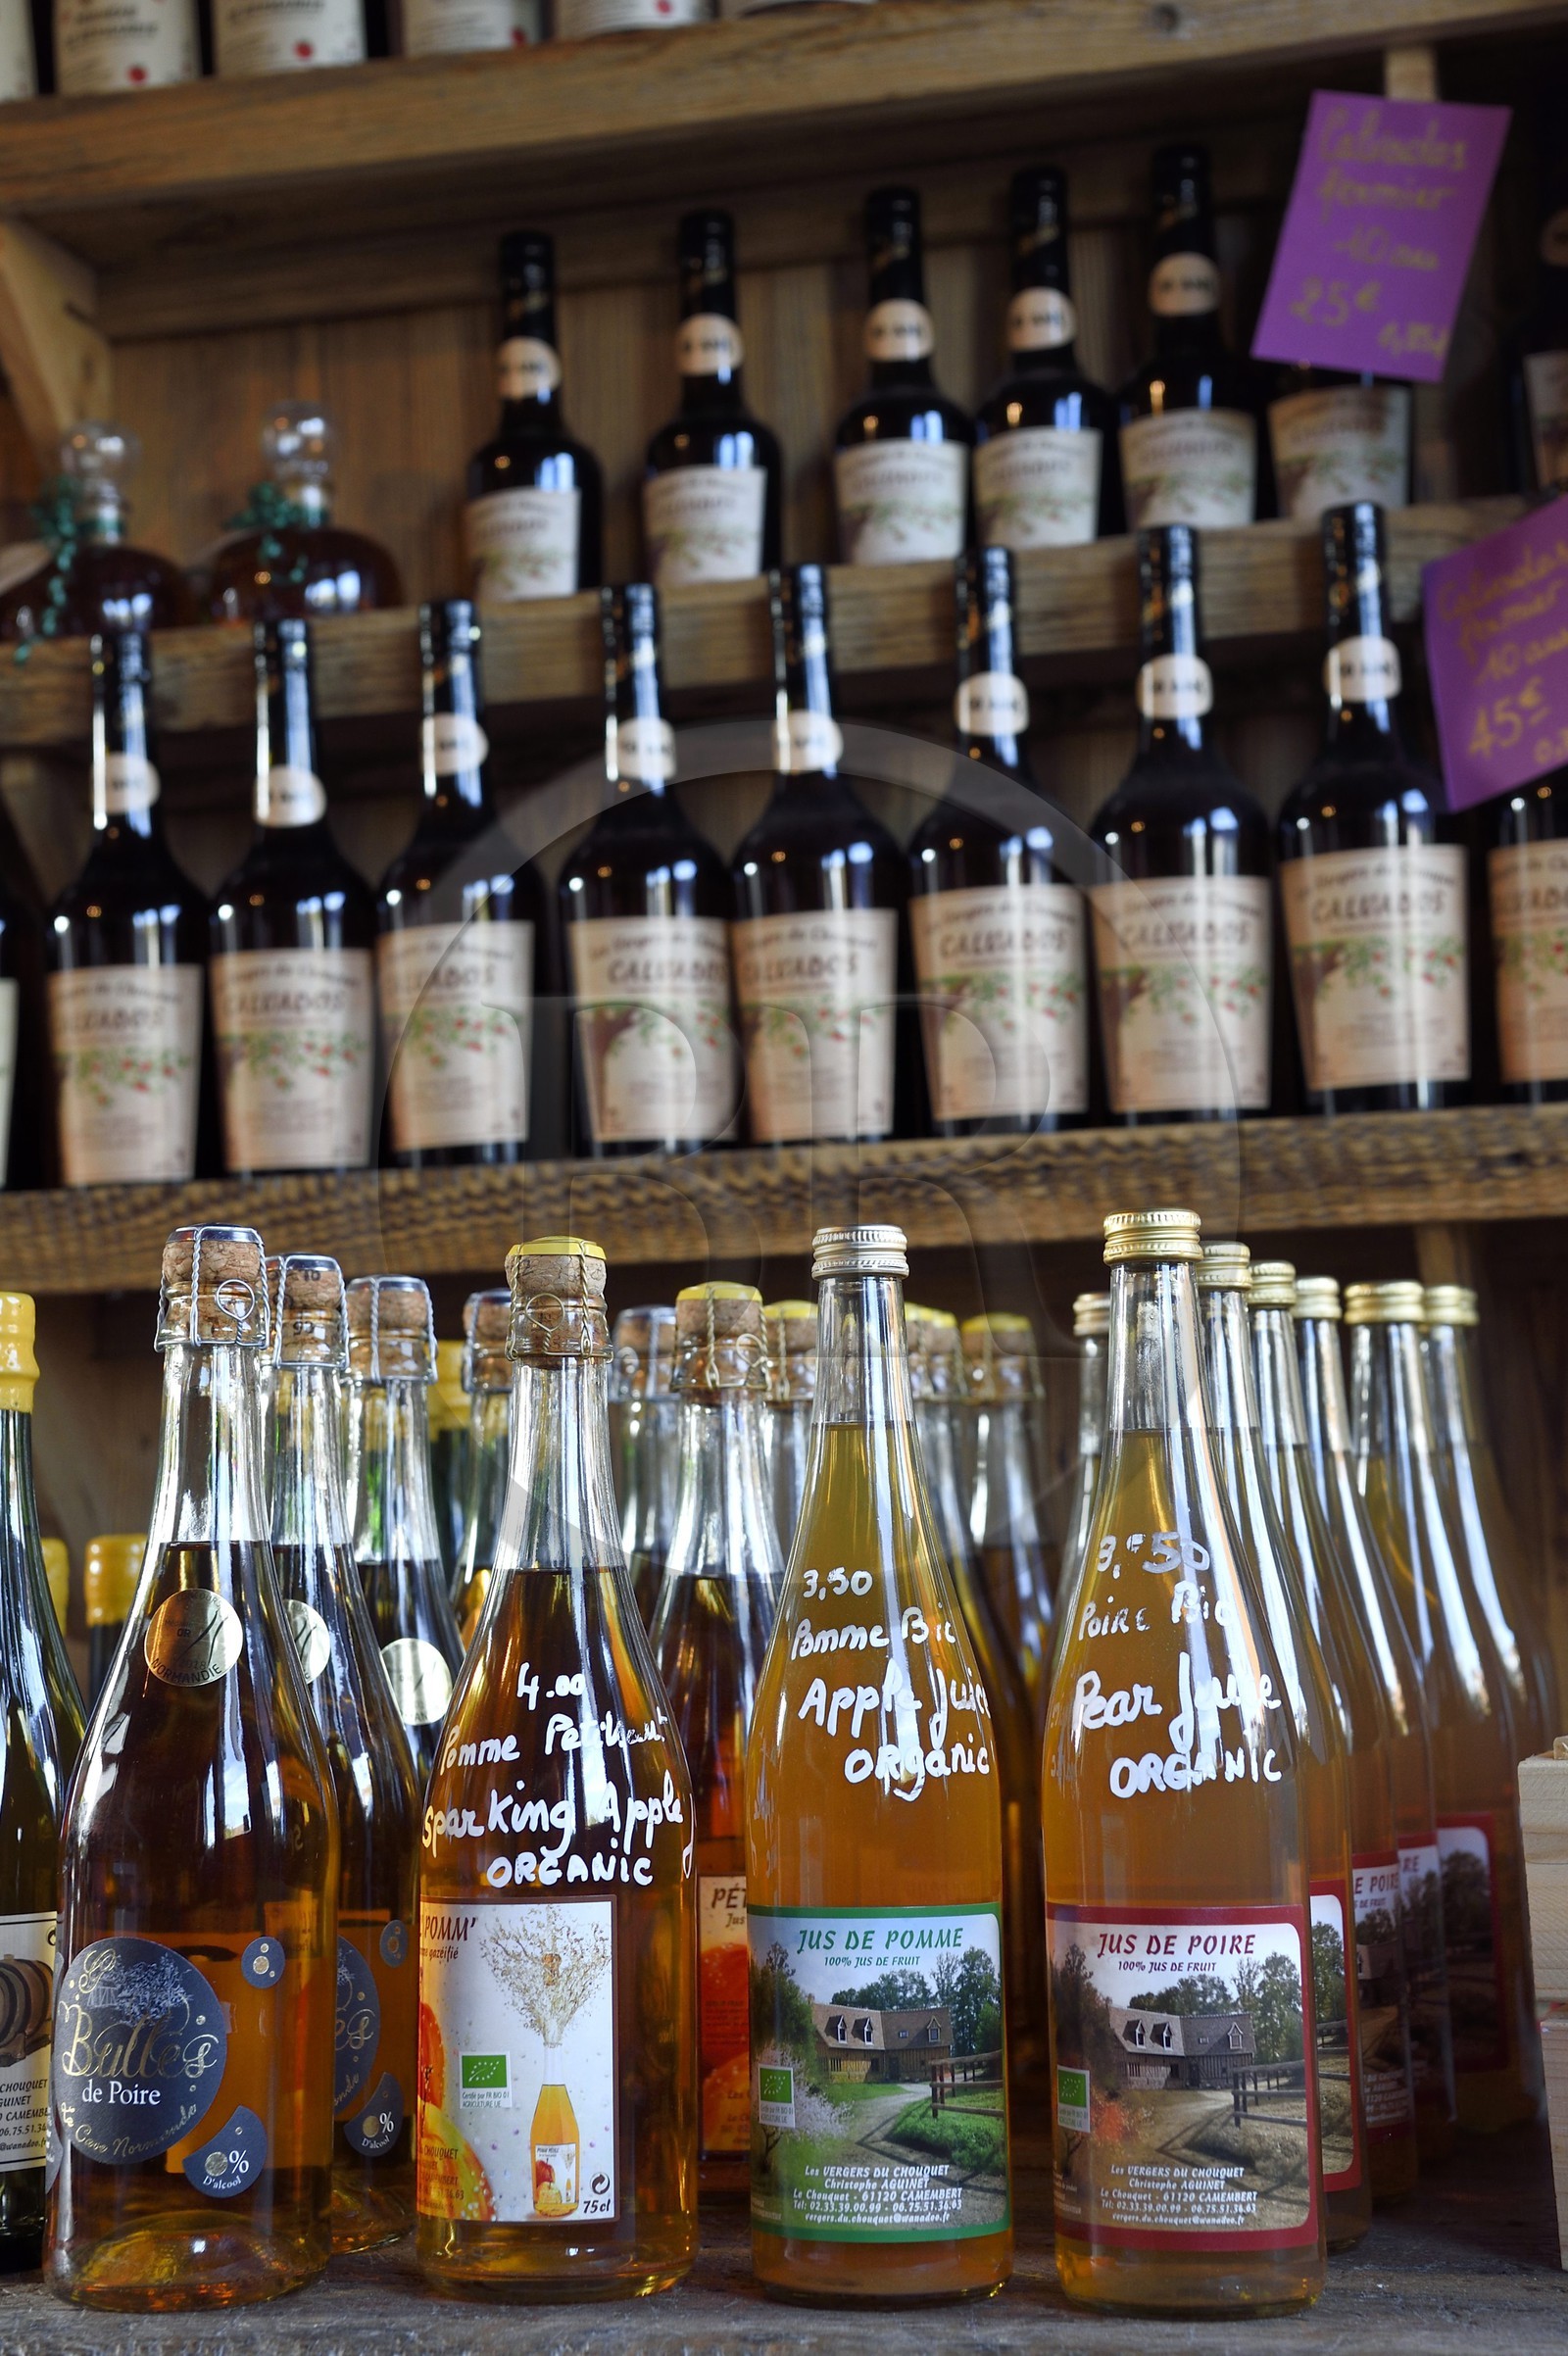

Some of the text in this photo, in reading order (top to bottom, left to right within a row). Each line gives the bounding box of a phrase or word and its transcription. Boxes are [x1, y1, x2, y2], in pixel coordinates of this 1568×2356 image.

[803, 1567, 873, 1601] 3,50
[791, 1618, 890, 1660] Pomme
[151, 1657, 221, 1684] NORMANDIE
[798, 1657, 923, 1739] Apple
[1072, 1670, 1163, 1731] Pear
[440, 1724, 521, 1776] Pomme
[599, 1769, 684, 1856] Apple
[797, 1927, 963, 1954] JUS DE POMME
[1098, 1933, 1256, 1958] JUS DE POIRE
[824, 1955, 921, 1969] 100% JUS DE FRUIT
[1118, 1961, 1217, 1974] 100% JUS DE FRUIT
[57, 1996, 220, 2080] Bulles
[82, 2080, 161, 2106] de Poire
[379, 2111, 394, 2134] %
[361, 2135, 390, 2150] D'alcool
[228, 2149, 250, 2175] %
[805, 2165, 950, 2180] Les VERGERS DU CHOUQUET
[1110, 2164, 1245, 2181] Les VERGERS DU CHOUQUET
[202, 2175, 243, 2190] D'alcool
[793, 2187, 804, 2198] Le
[806, 2188, 851, 2203] Chouquet
[861, 2190, 899, 2202] 61120
[901, 2187, 962, 2201] CAMEMBERT
[824, 2178, 930, 2192] Christophe AGUINET
[1101, 2186, 1109, 2197] Le
[1111, 2187, 1152, 2203] Chouquet
[1162, 2191, 1196, 2203] 61120
[1199, 2190, 1258, 2203] CAMEMBERT
[1129, 2178, 1225, 2192] Christophe AGUINET
